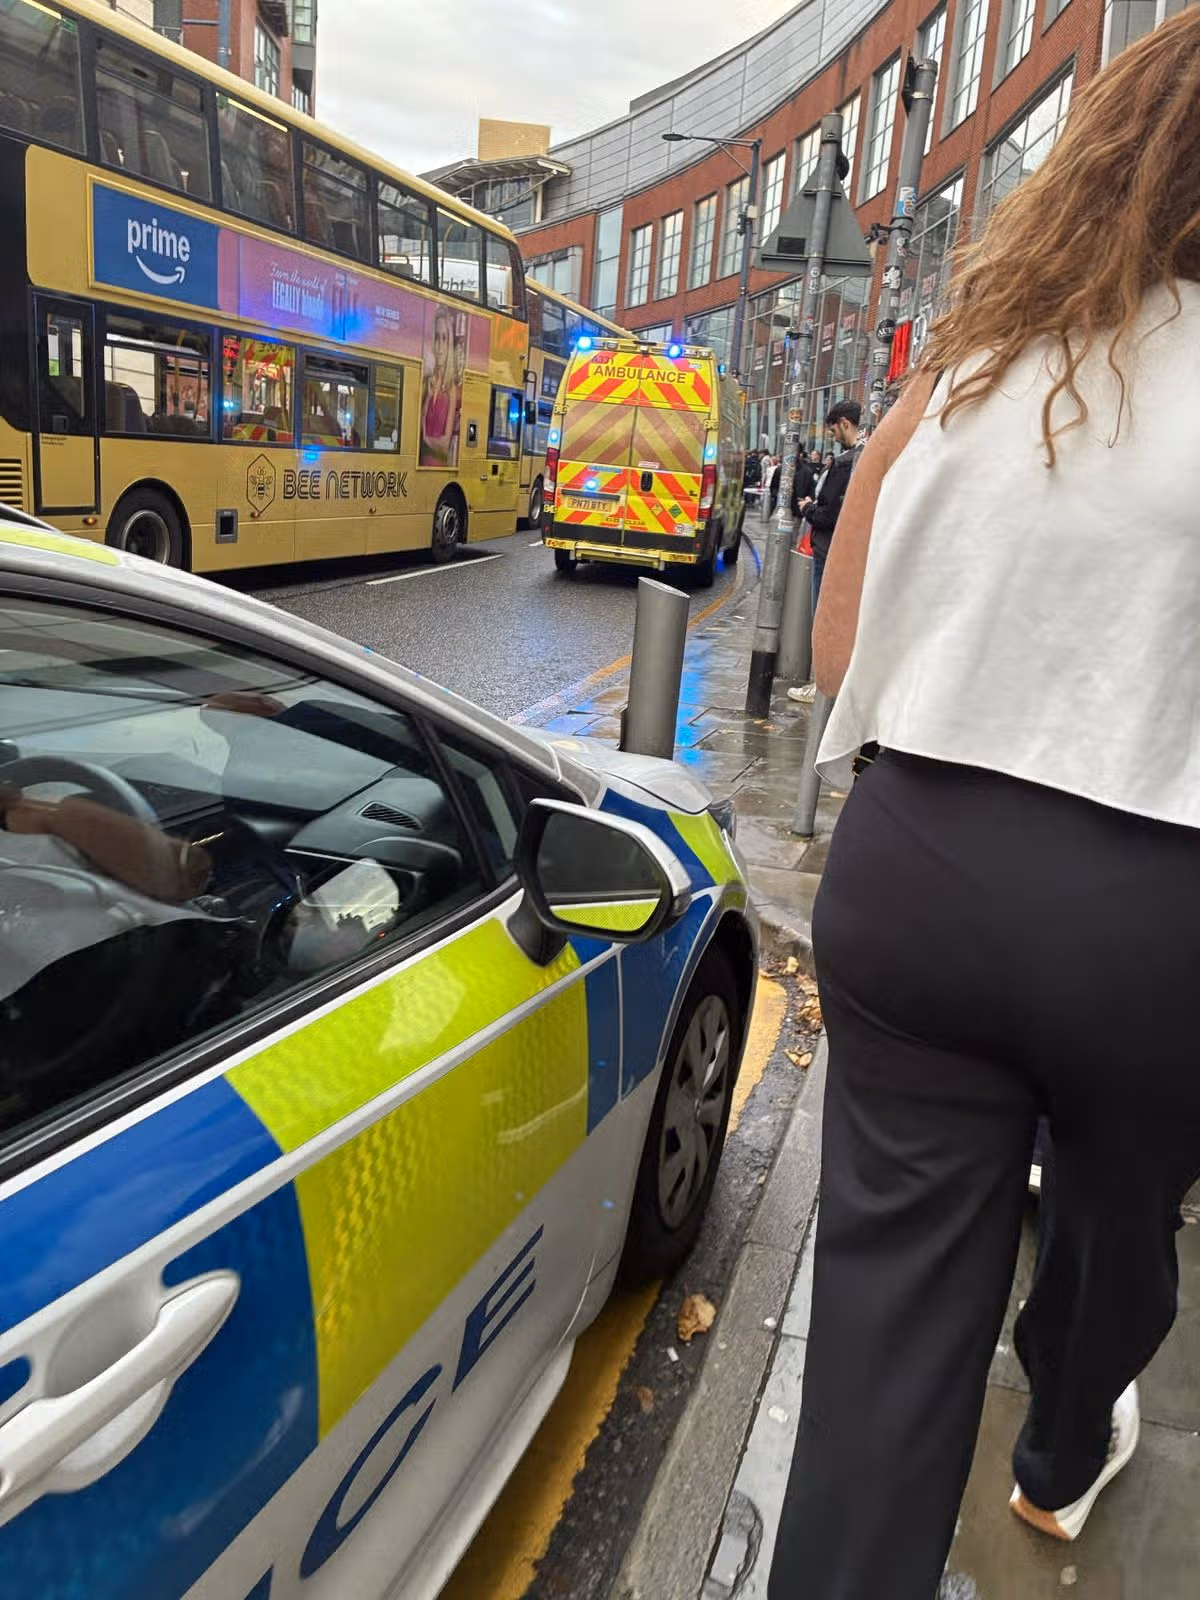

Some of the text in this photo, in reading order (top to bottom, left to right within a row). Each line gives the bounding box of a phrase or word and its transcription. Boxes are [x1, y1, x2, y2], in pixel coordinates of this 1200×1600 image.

[127, 217, 191, 263] prime
[272, 279, 301, 314] LEGALLY
[592, 365, 687, 384] AMBULANCE
[283, 469, 409, 499] BEE NETWORK
[243, 1224, 544, 1600] CE
